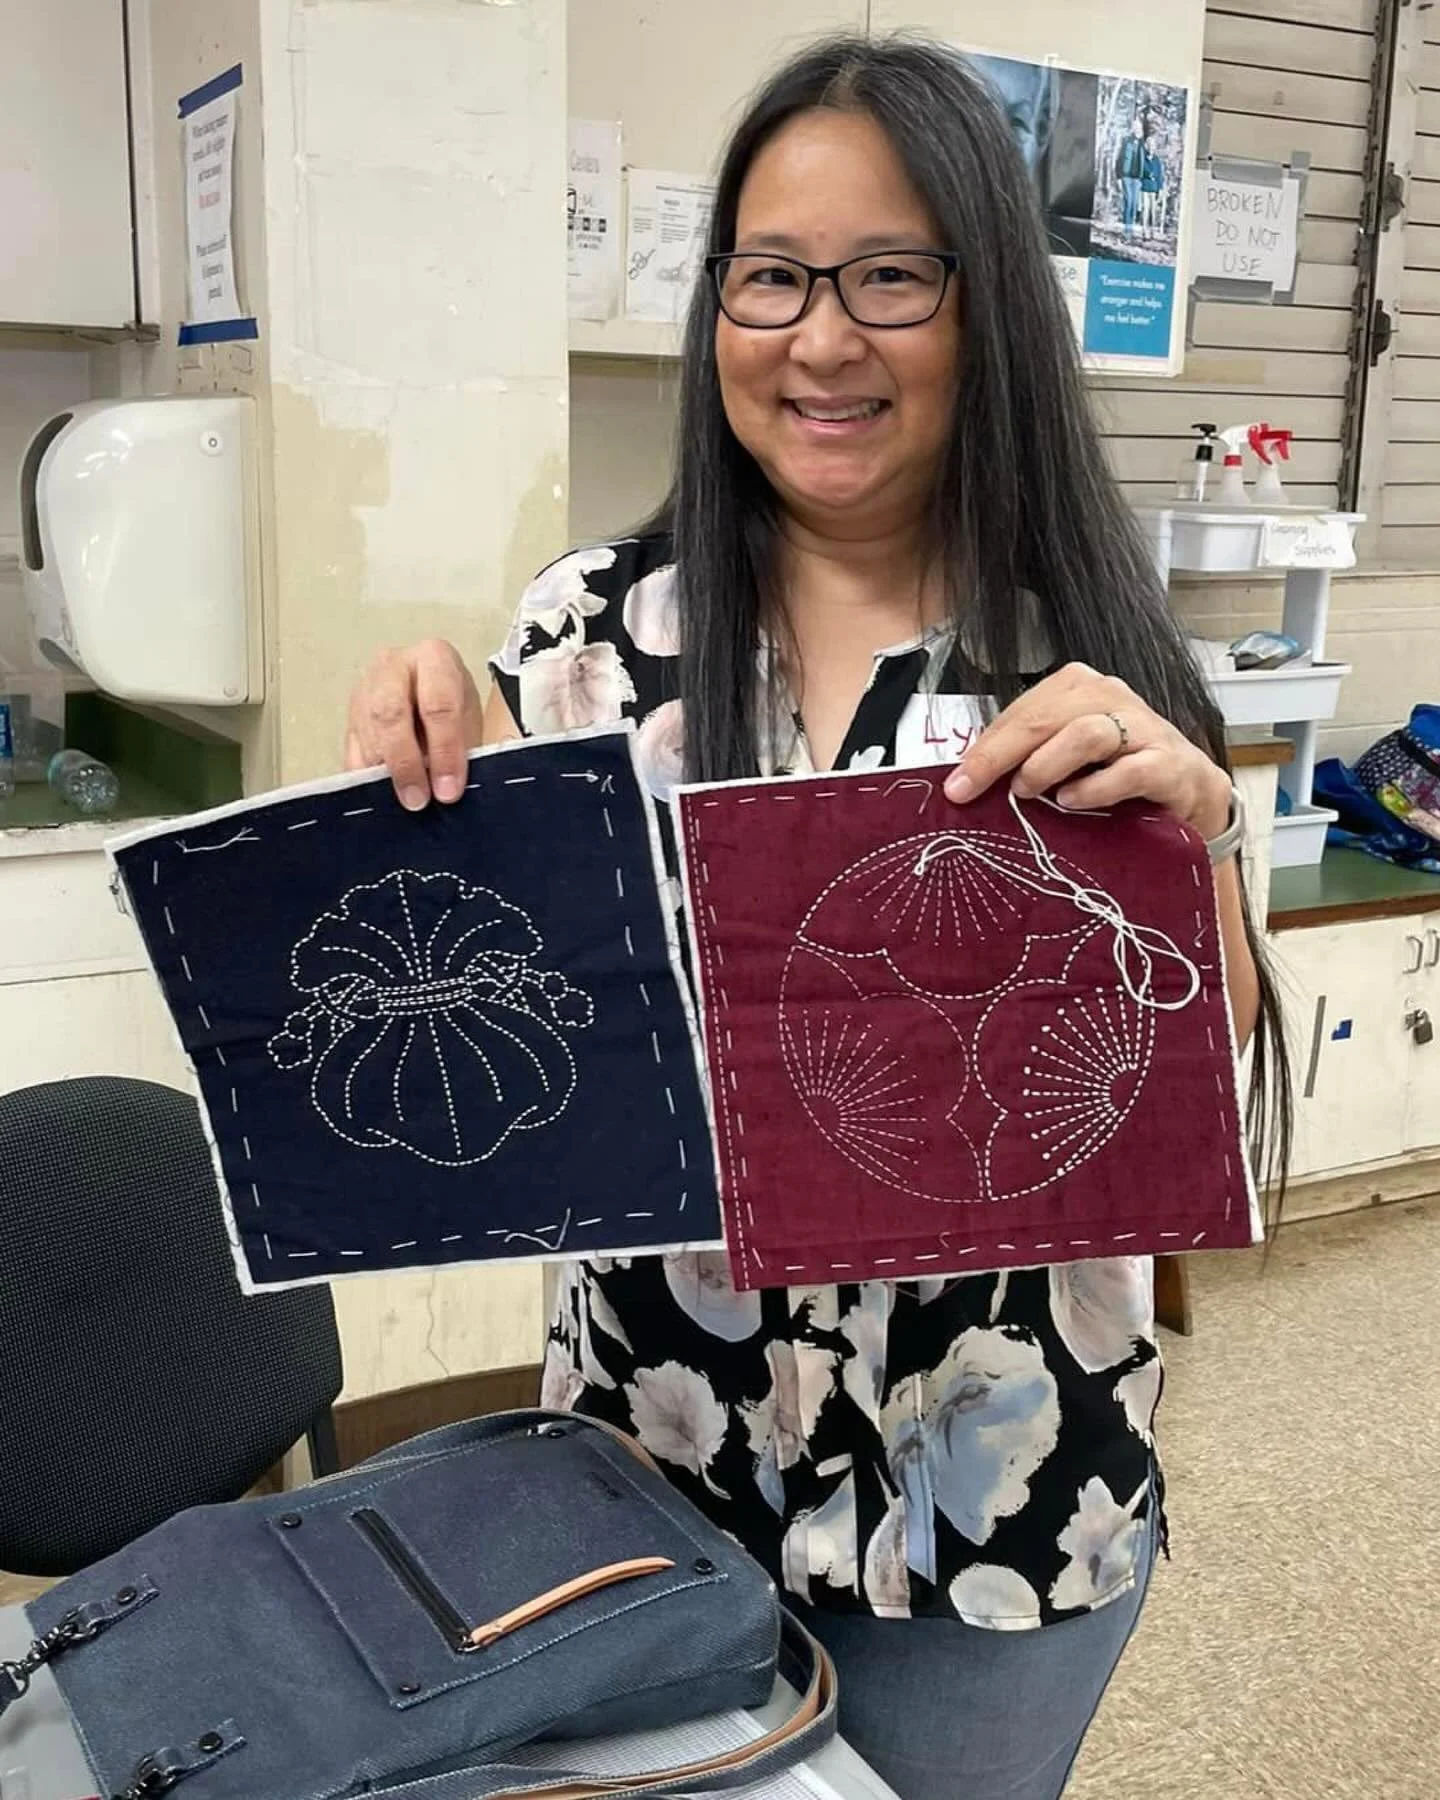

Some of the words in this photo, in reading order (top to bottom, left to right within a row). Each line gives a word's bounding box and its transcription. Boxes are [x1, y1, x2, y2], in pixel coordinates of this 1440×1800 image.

[1208, 188, 1284, 219] BROKEN
[1216, 220, 1240, 241] DO
[1248, 226, 1281, 247] NOT
[1223, 252, 1263, 277] USE
[924, 714, 984, 756] Ly
